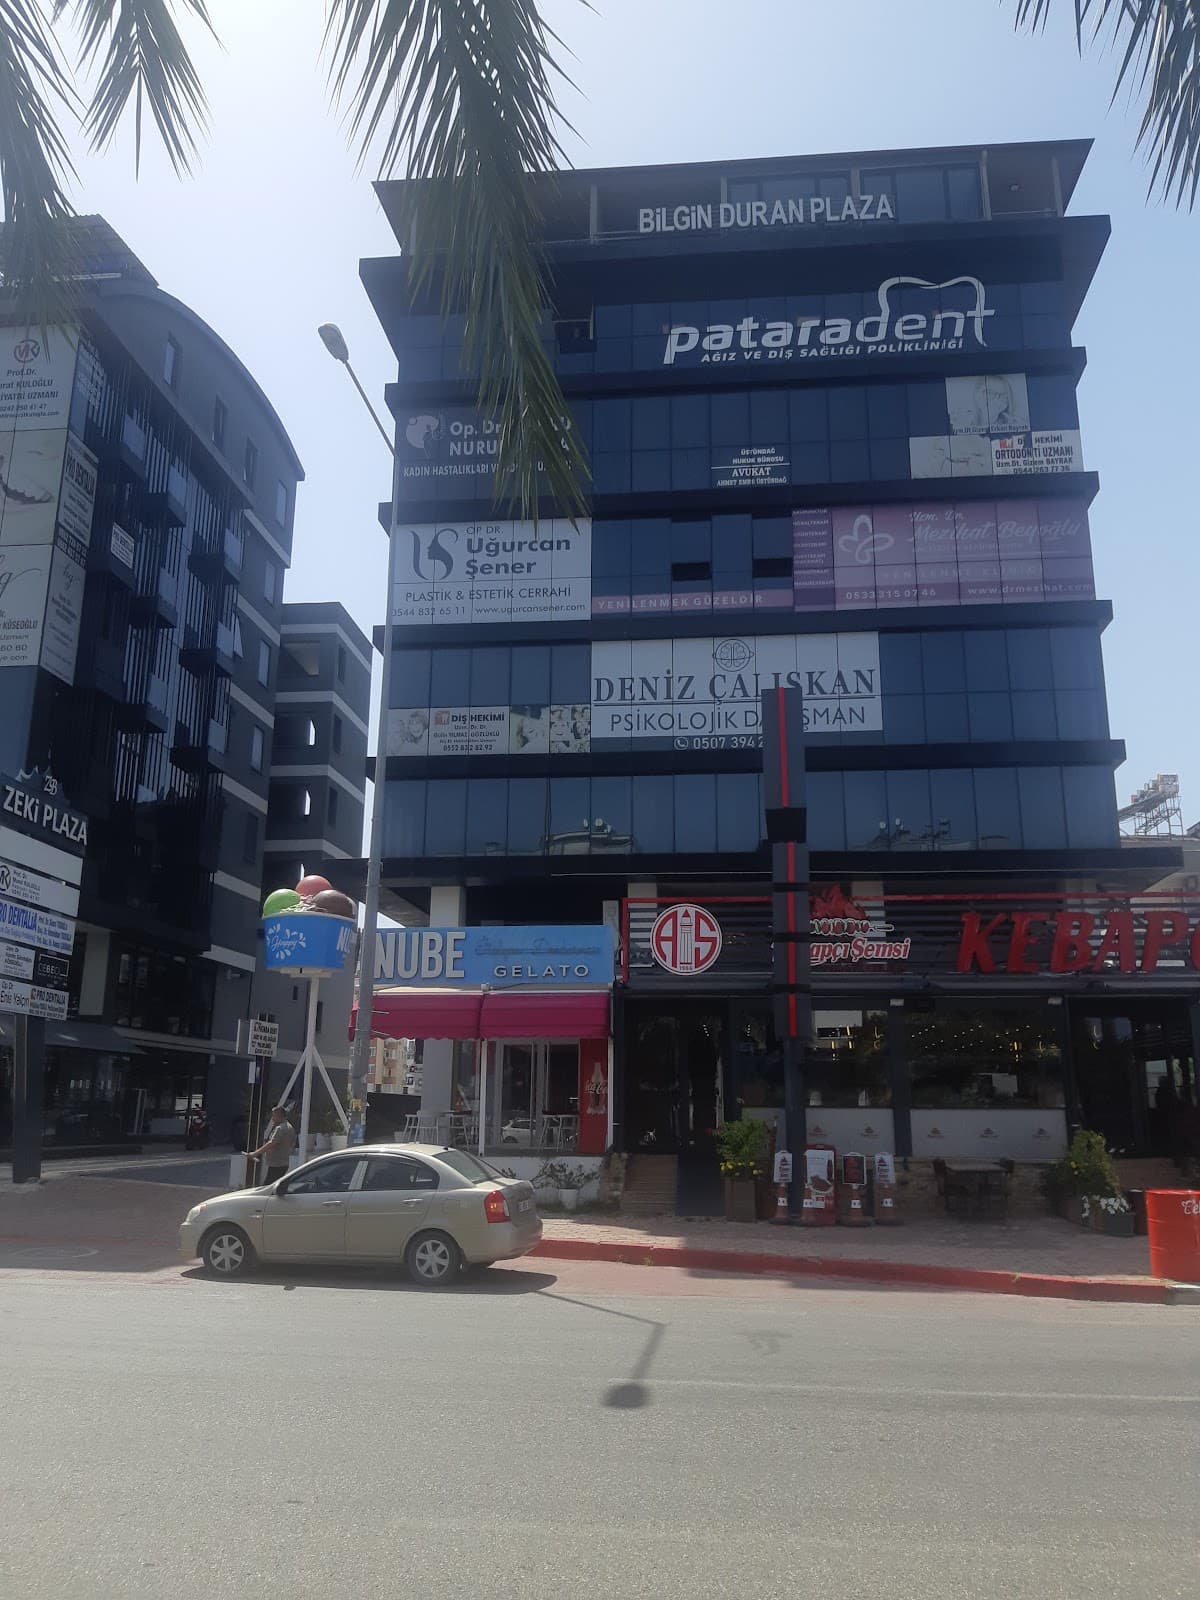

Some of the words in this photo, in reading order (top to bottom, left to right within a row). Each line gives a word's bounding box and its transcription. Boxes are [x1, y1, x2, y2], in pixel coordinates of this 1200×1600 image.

[720, 198, 803, 228] DURAN
[810, 193, 895, 222] PLAZA
[662, 276, 995, 364] pataradent
[700, 352, 736, 363] AĞIZ
[743, 351, 761, 360] VE
[768, 348, 793, 360] DİŞ
[800, 343, 860, 358] SAĞLIĞI
[867, 338, 964, 353] POLİKLİNİĞİ
[1034, 433, 1063, 445] HEKİMİ
[1042, 446, 1074, 457] UZMANI
[403, 465, 431, 478] KADIN
[432, 462, 489, 476] HASTALIKLARI
[732, 467, 772, 477] AVUKAT
[466, 536, 571, 558] Uğurcan
[465, 559, 537, 580] Şener
[405, 589, 452, 602] PLASTİK
[455, 590, 464, 600] &
[468, 587, 514, 601] ESTETİK
[518, 583, 572, 598] CERRAHİ
[592, 669, 696, 702] DENİZ
[451, 713, 468, 725] DİŞ
[470, 711, 505, 722] HEKİMİ
[610, 708, 739, 734] PSİKOLOJİK
[693, 736, 726, 749] 0507
[730, 736, 755, 749] 394
[42, 803, 88, 846] PLAZA
[374, 931, 466, 979] NUBE
[850, 937, 911, 962] Şemsi
[493, 964, 590, 978] GELATO
